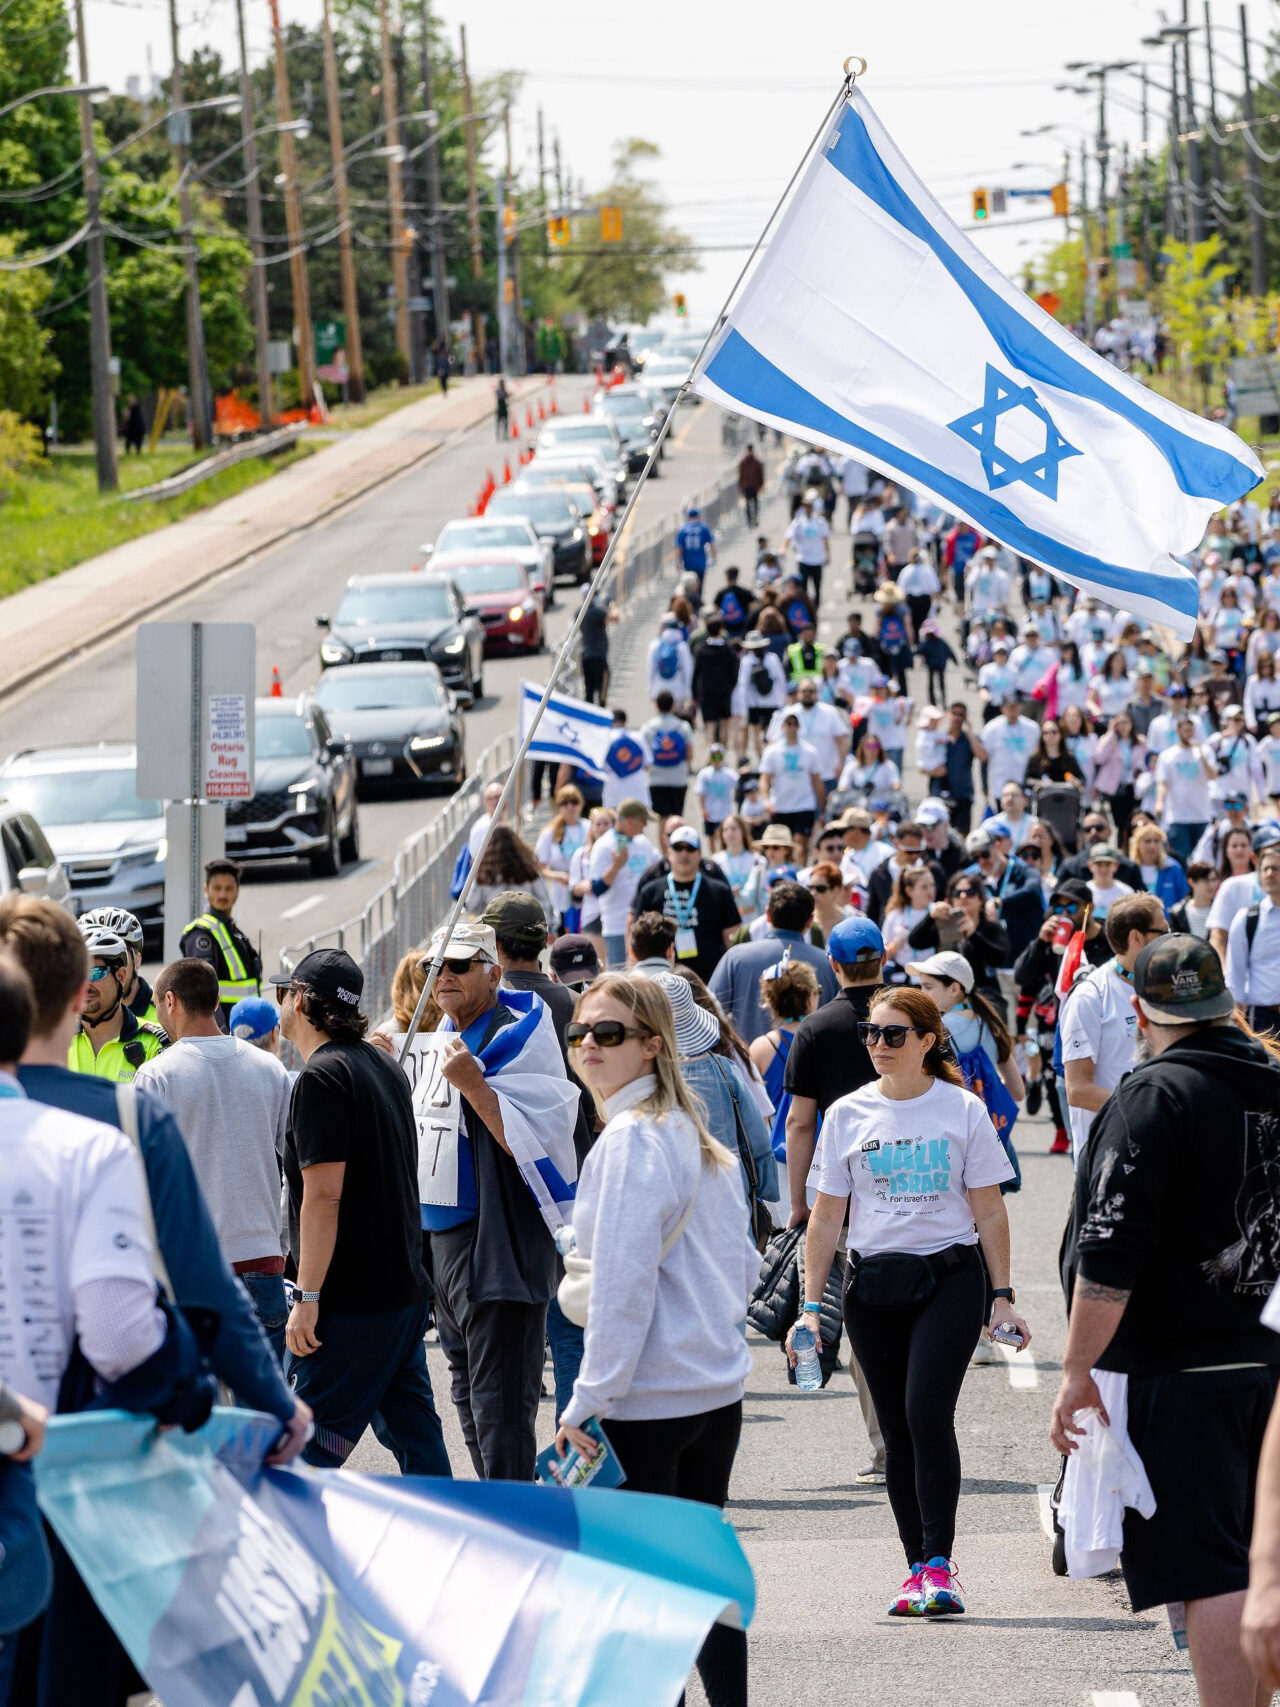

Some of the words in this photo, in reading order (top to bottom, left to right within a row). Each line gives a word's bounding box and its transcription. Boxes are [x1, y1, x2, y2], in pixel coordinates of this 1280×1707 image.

[211, 743, 245, 752] Ontario
[218, 755, 238, 768] Rug
[208, 770, 247, 782] Cleaning
[867, 1139, 951, 1176] WALK
[890, 1172, 950, 1194] ISRAEL
